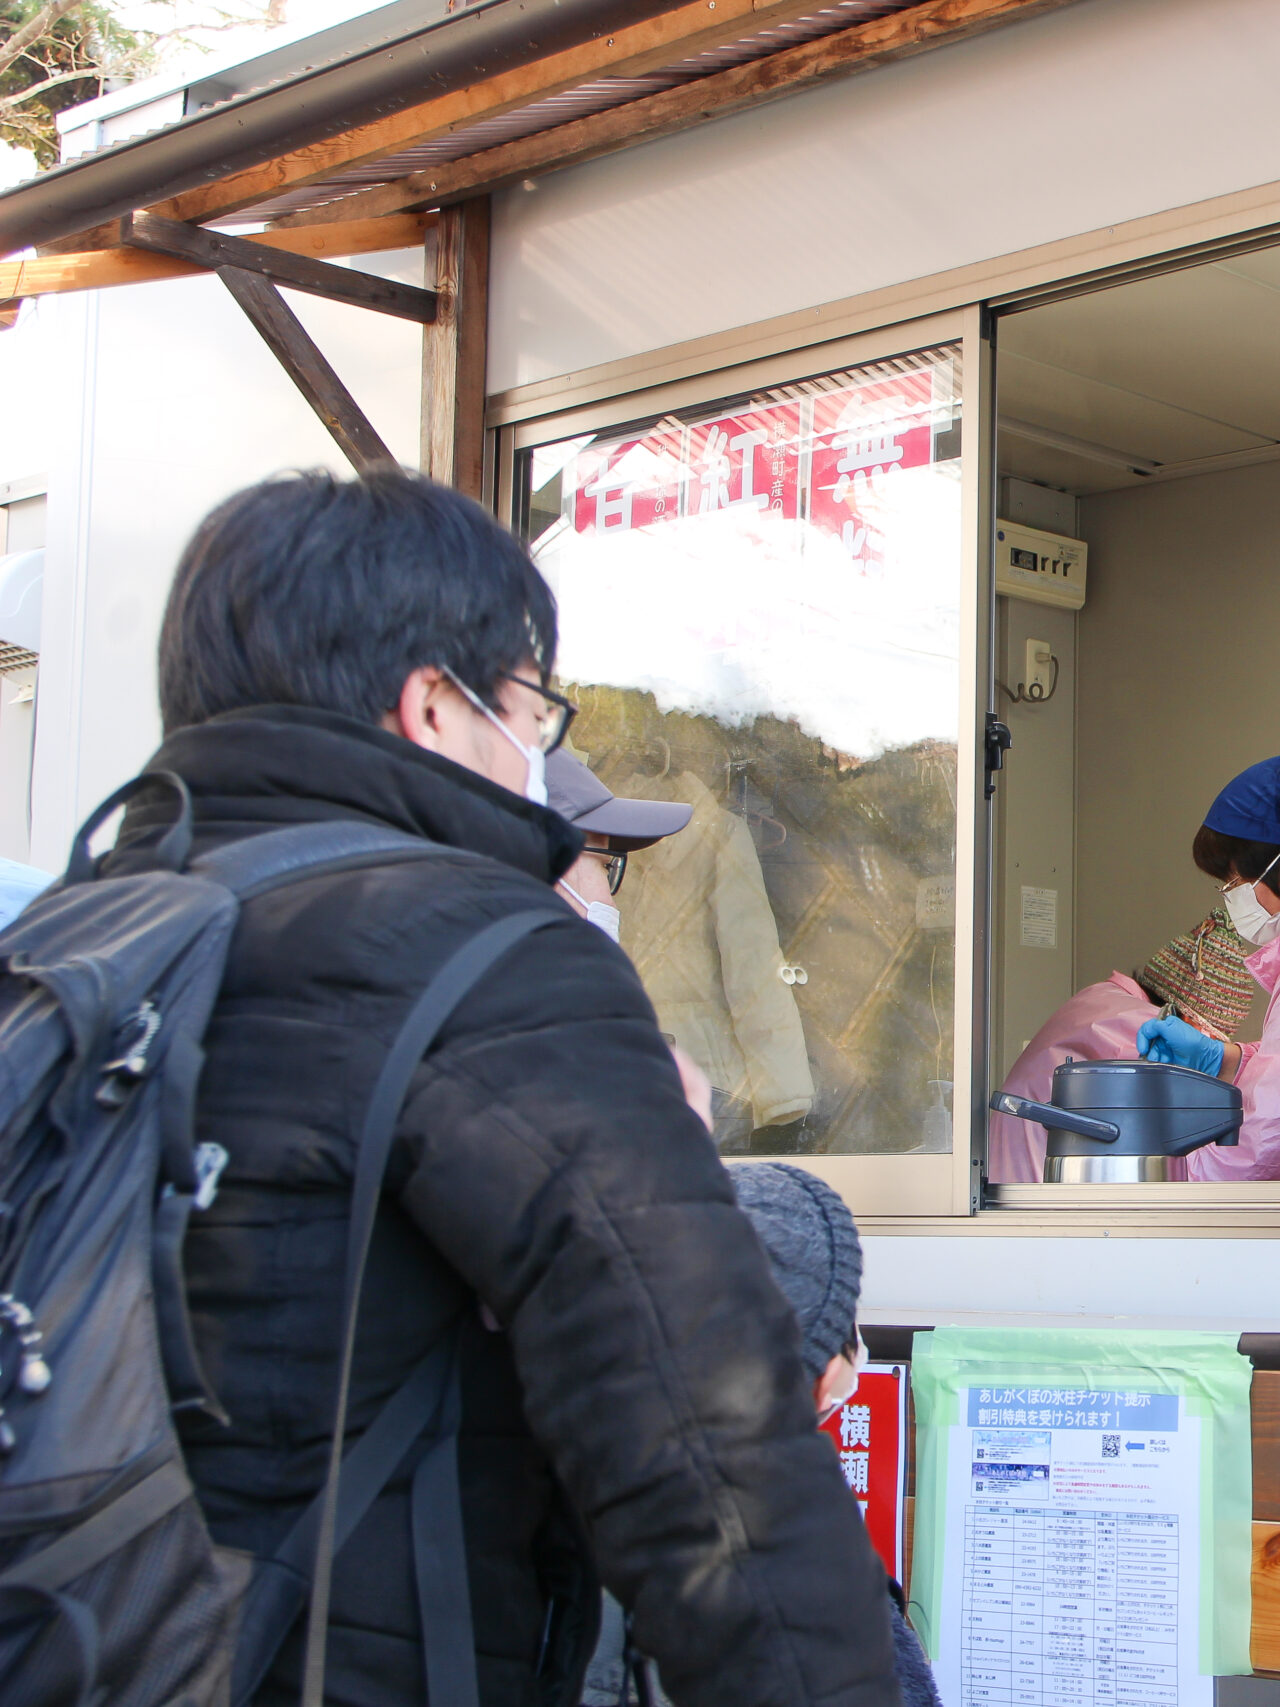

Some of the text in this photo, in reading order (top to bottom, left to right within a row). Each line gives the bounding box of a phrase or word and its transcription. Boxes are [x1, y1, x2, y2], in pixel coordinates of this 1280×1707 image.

[978, 1408, 1120, 1427] 割引特典を受けられます！
[839, 1404, 871, 1523] 横瀬
